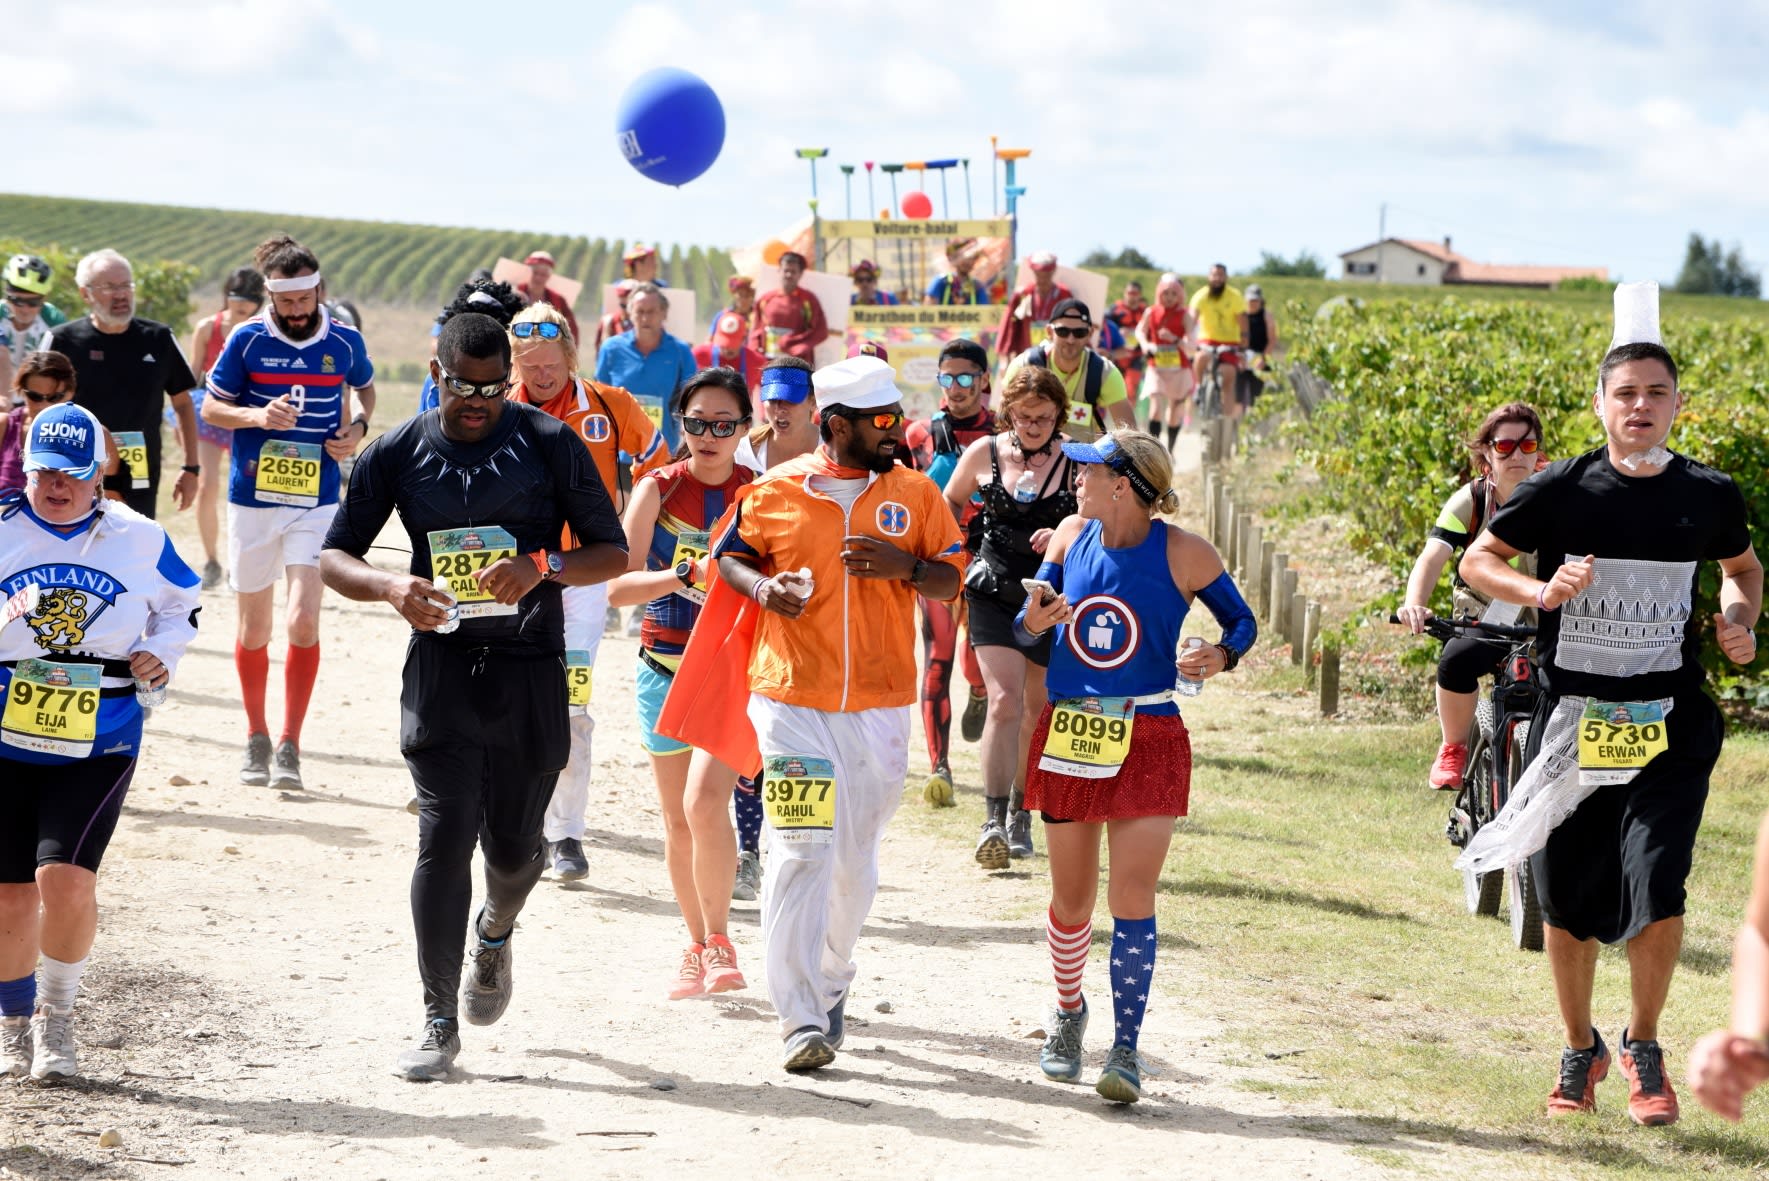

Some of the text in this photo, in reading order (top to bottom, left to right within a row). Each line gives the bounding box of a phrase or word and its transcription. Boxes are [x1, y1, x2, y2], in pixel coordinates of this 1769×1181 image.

[873, 223, 958, 235] Voiture-balai
[854, 311, 915, 323] Marathon
[919, 311, 934, 322] du
[291, 384, 305, 412] 9
[39, 422, 87, 442] SUOMI
[261, 457, 317, 478] 2650
[266, 475, 310, 488] LAURENT
[9, 567, 114, 596] FINLAND
[13, 681, 96, 715] 9776
[35, 712, 67, 729] EIJA
[1053, 711, 1127, 743] 8099
[1583, 720, 1661, 745] 5730
[1071, 738, 1102, 755] ERIN
[1598, 745, 1647, 758] ERWAN
[765, 780, 832, 802] 3977
[776, 804, 815, 817] RAHUL
